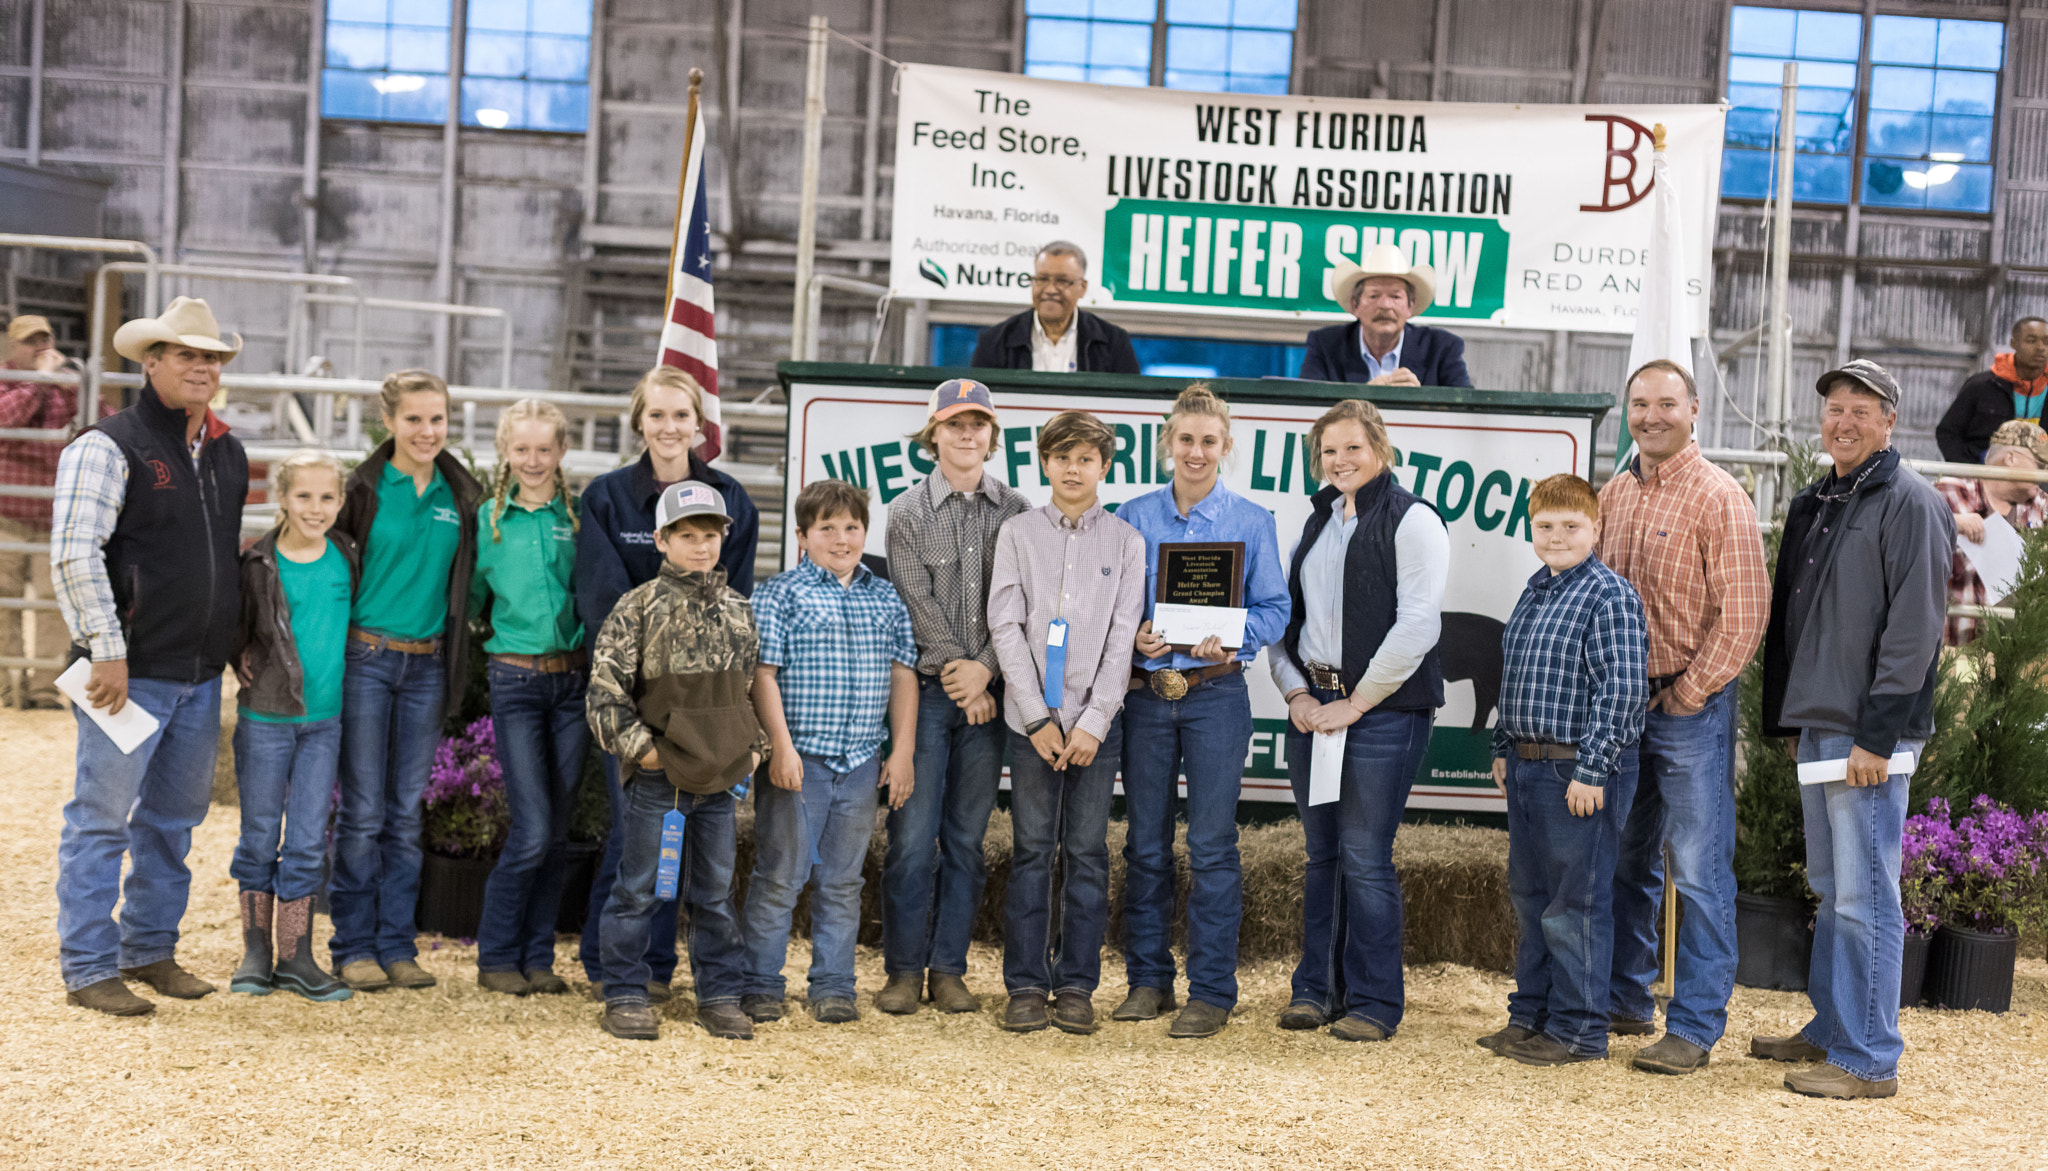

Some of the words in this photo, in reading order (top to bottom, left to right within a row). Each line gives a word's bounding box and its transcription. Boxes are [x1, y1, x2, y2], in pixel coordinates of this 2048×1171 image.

[974, 89, 1031, 117] The
[912, 121, 986, 151] Feed
[998, 127, 1088, 162] Store,
[1196, 103, 1282, 148] WEST
[1295, 110, 1428, 154] FLORIDA
[970, 162, 1025, 191] Inc.
[1107, 155, 1278, 206] LIVESTOCK
[1292, 166, 1513, 216] ASSOCIATION
[933, 205, 998, 223] Havana,
[1002, 207, 1060, 225] Florida
[912, 236, 1000, 256] Authorized
[1127, 212, 1304, 300] HEIFER
[956, 263, 1032, 289] Nutre
[1600, 273, 1703, 297] ANS
[957, 381, 976, 399] F
[820, 440, 937, 505] WES
[1193, 590, 1225, 598] Champion
[1431, 768, 1493, 780] Established
